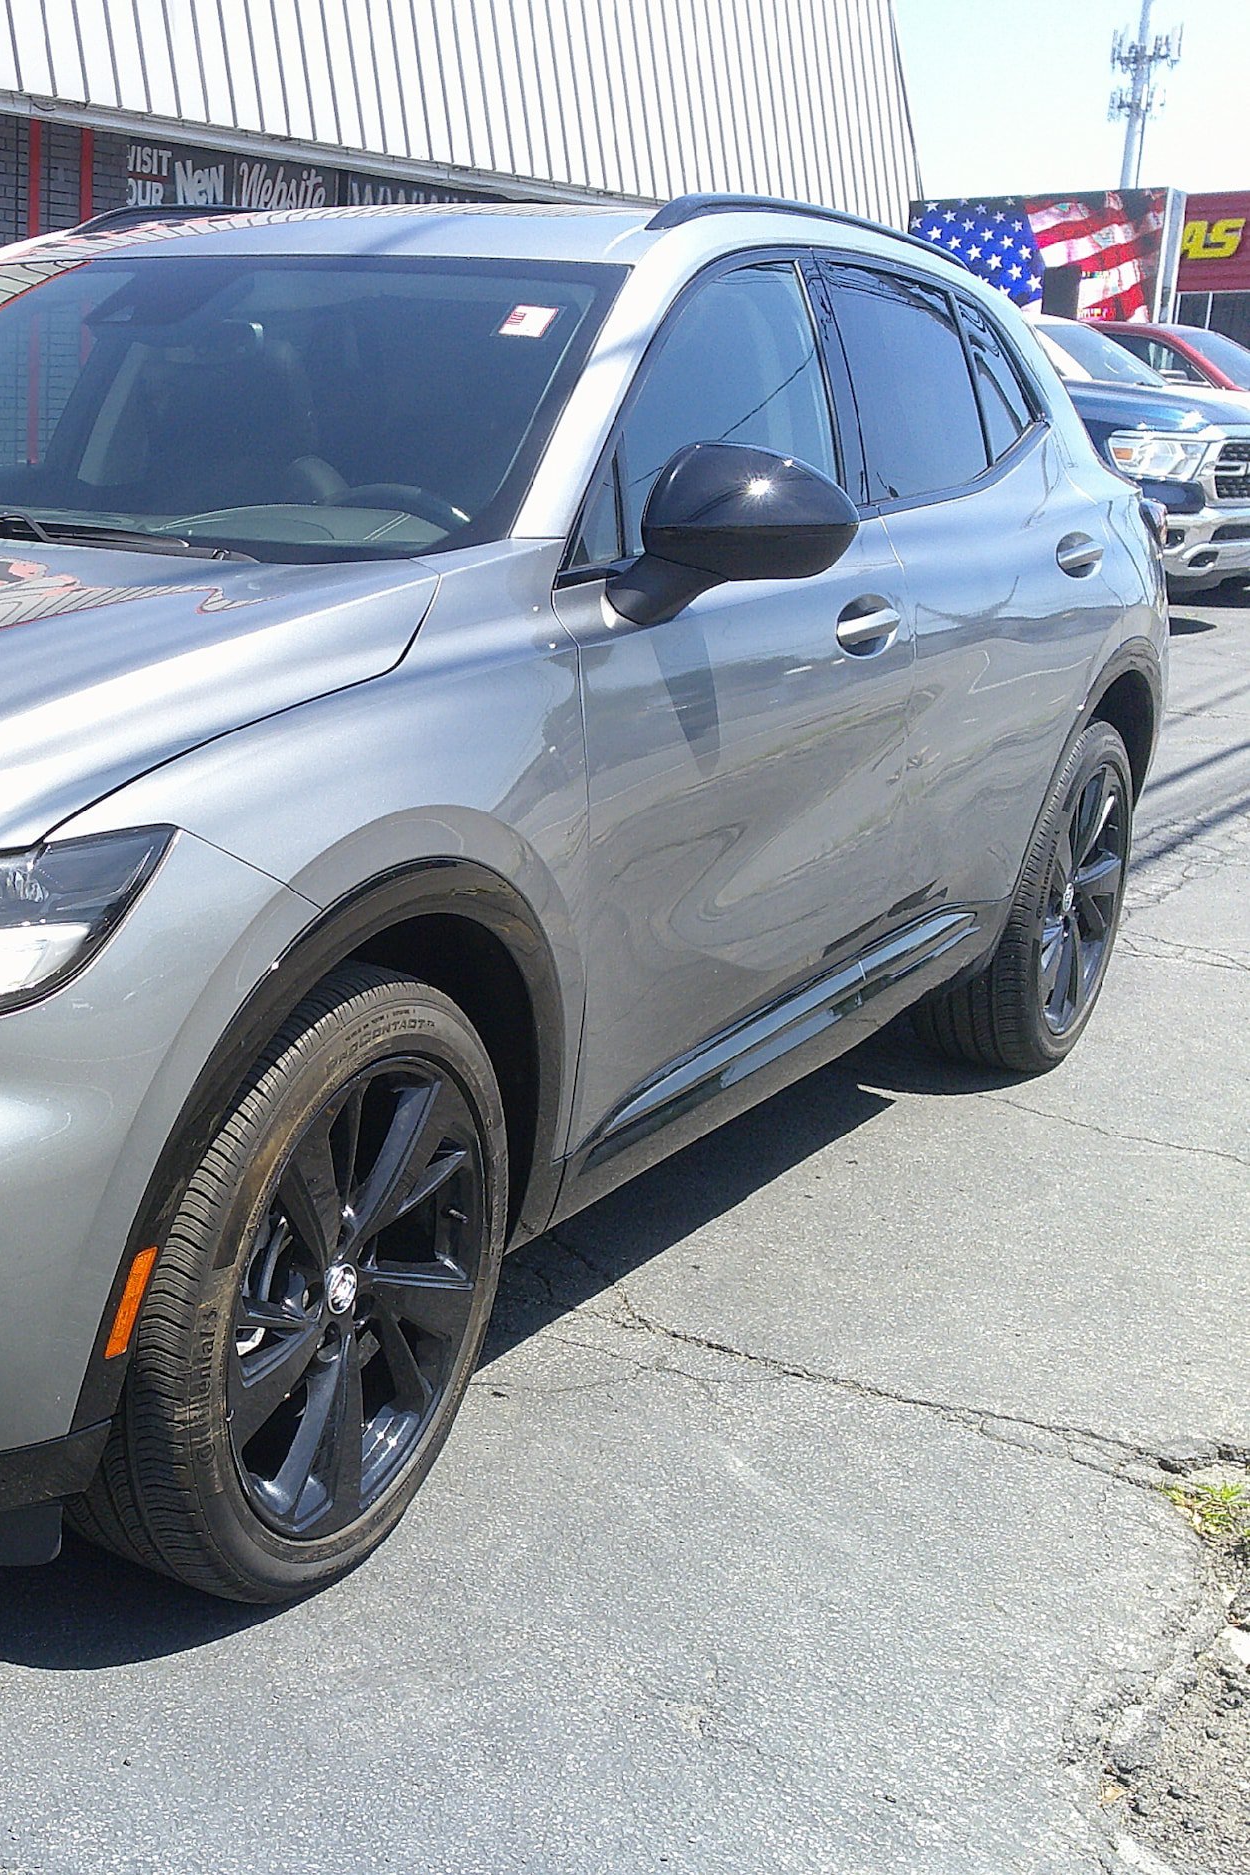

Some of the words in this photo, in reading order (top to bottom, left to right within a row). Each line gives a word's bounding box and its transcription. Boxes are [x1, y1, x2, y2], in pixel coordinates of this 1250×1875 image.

[126, 144, 172, 177] VISIT
[174, 159, 225, 205] New
[239, 161, 326, 210] Website
